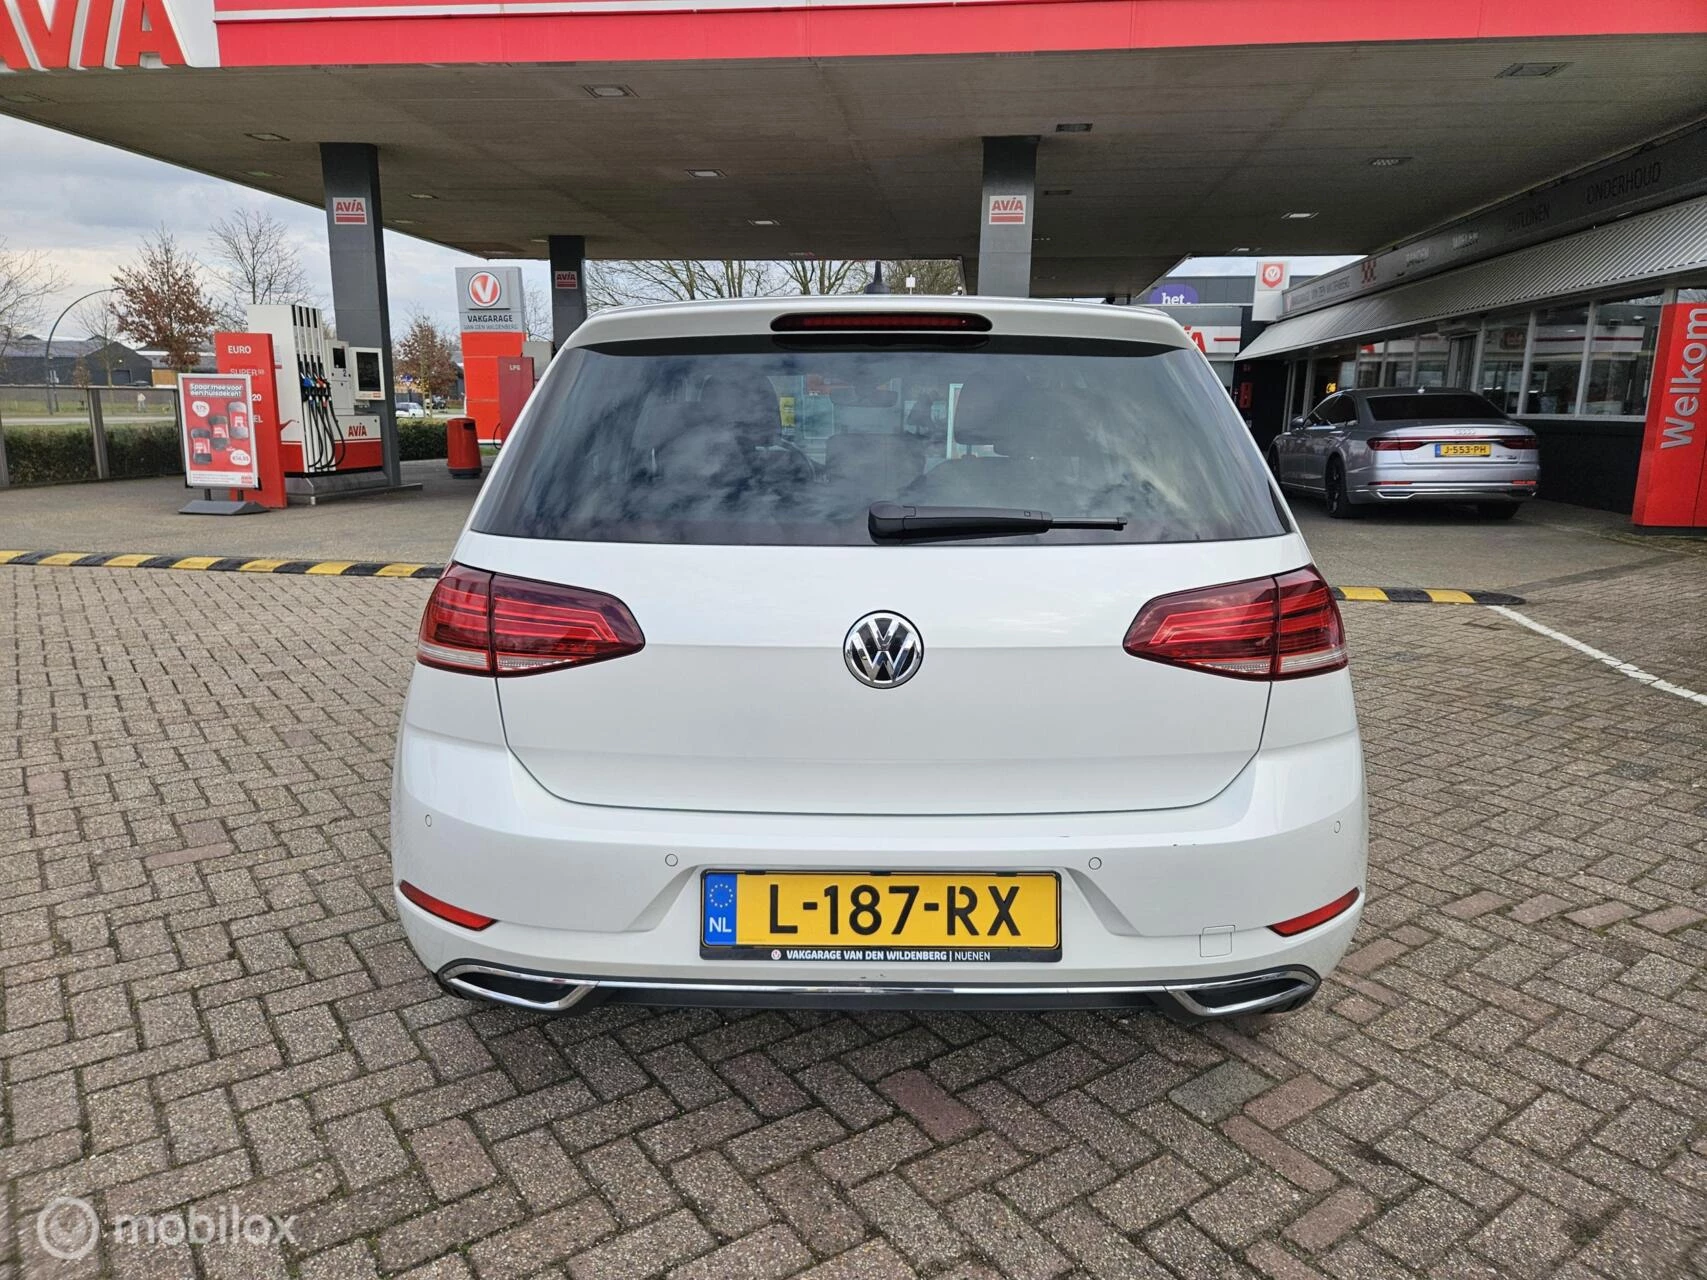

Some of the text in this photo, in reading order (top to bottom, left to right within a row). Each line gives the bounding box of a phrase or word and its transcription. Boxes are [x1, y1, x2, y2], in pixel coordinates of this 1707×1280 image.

[467, 314, 513, 322] VAKGARAGE
[227, 345, 252, 354] EURO
[1660, 308, 1707, 449] Welkom
[1444, 446, 1487, 454] J-553-PH
[769, 884, 1021, 936] L-187-RX
[709, 917, 732, 933] NL
[786, 950, 991, 961] VAKGARAGE VAN DEN WILDENBERG NUENEN
